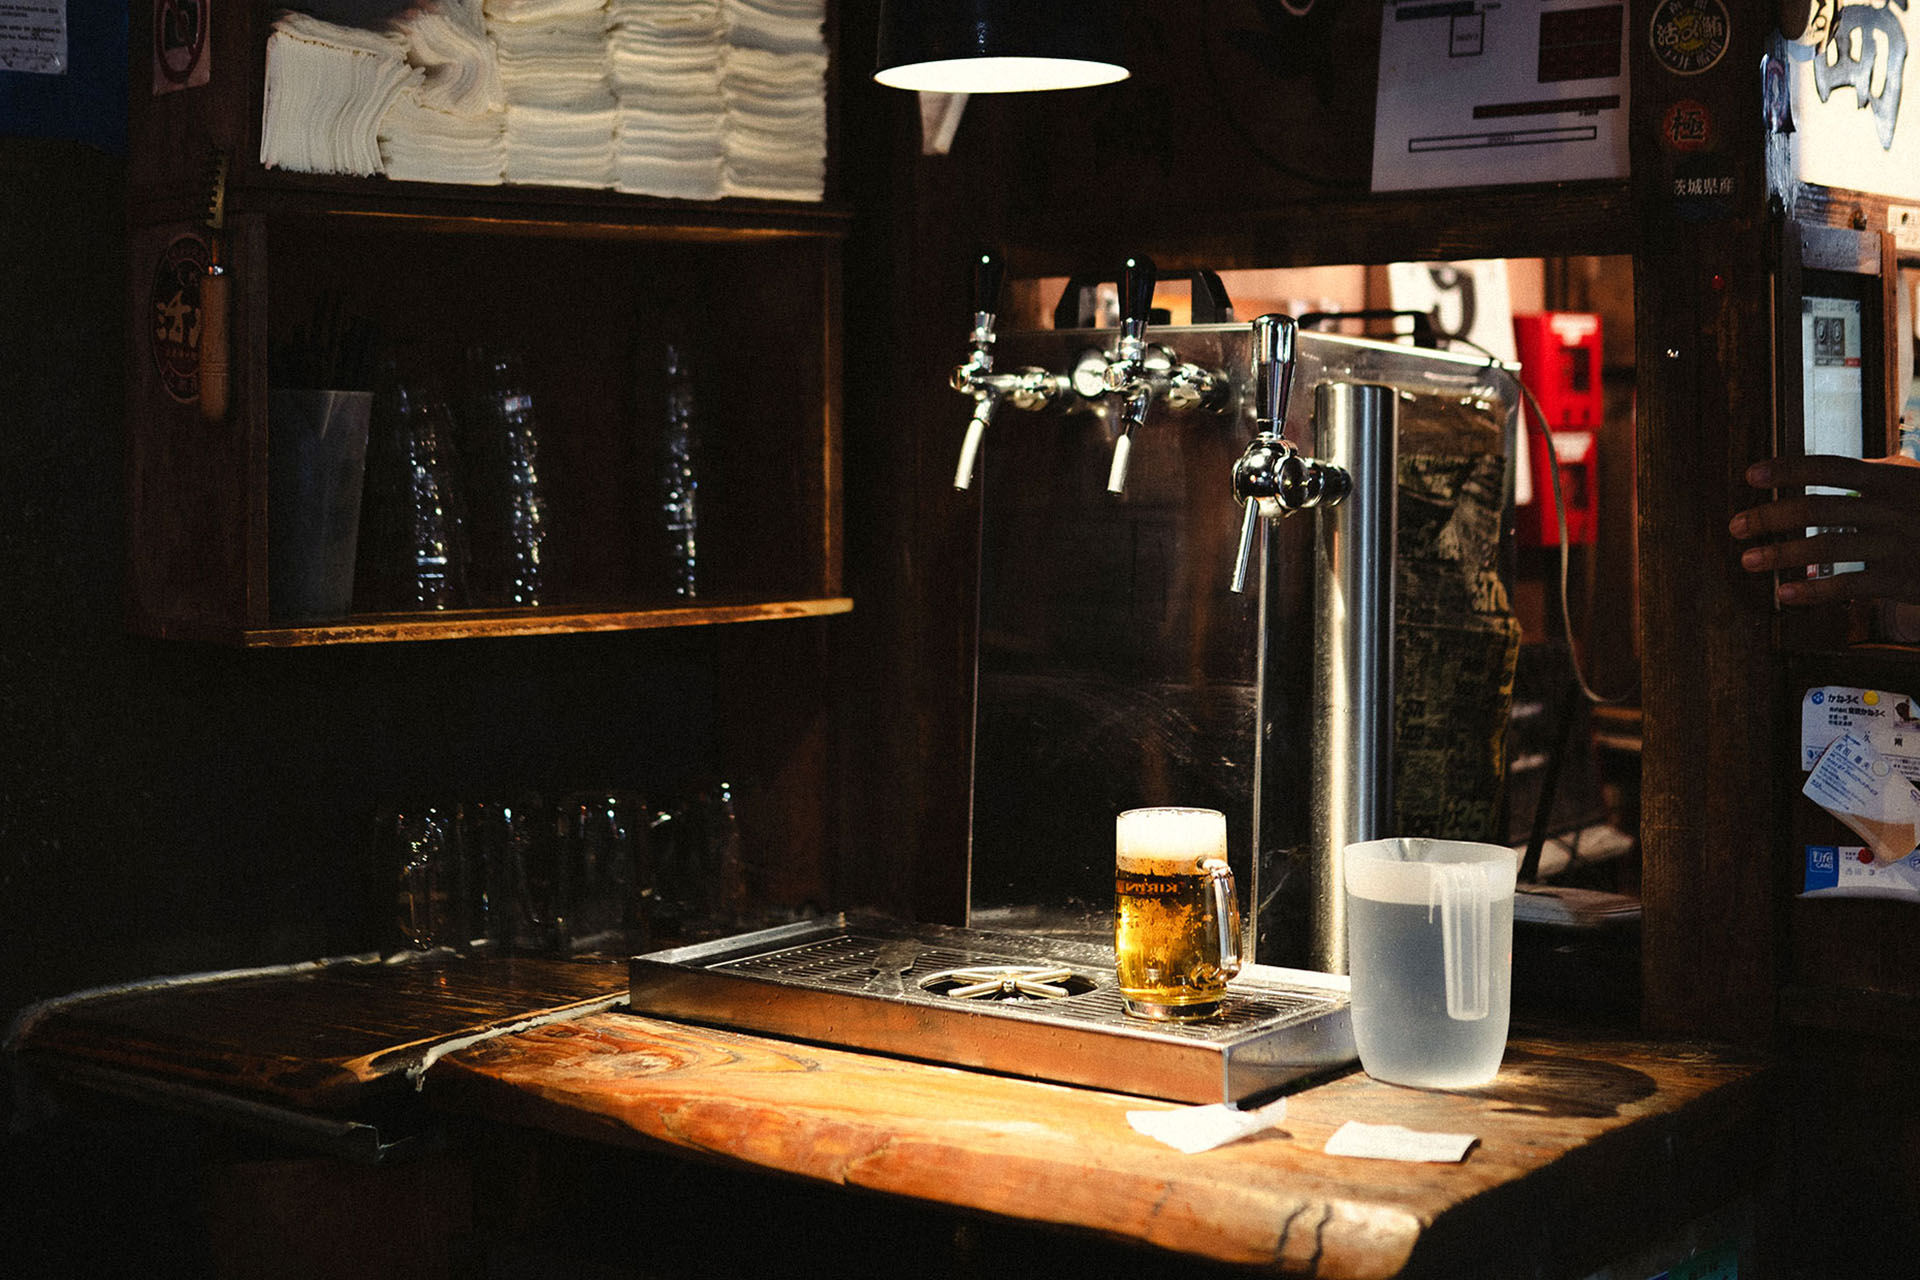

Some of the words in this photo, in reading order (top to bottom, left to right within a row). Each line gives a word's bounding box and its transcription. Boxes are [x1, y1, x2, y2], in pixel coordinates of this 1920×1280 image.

[1671, 108, 1705, 142] 極
[1673, 177, 1734, 196] 茨城県産
